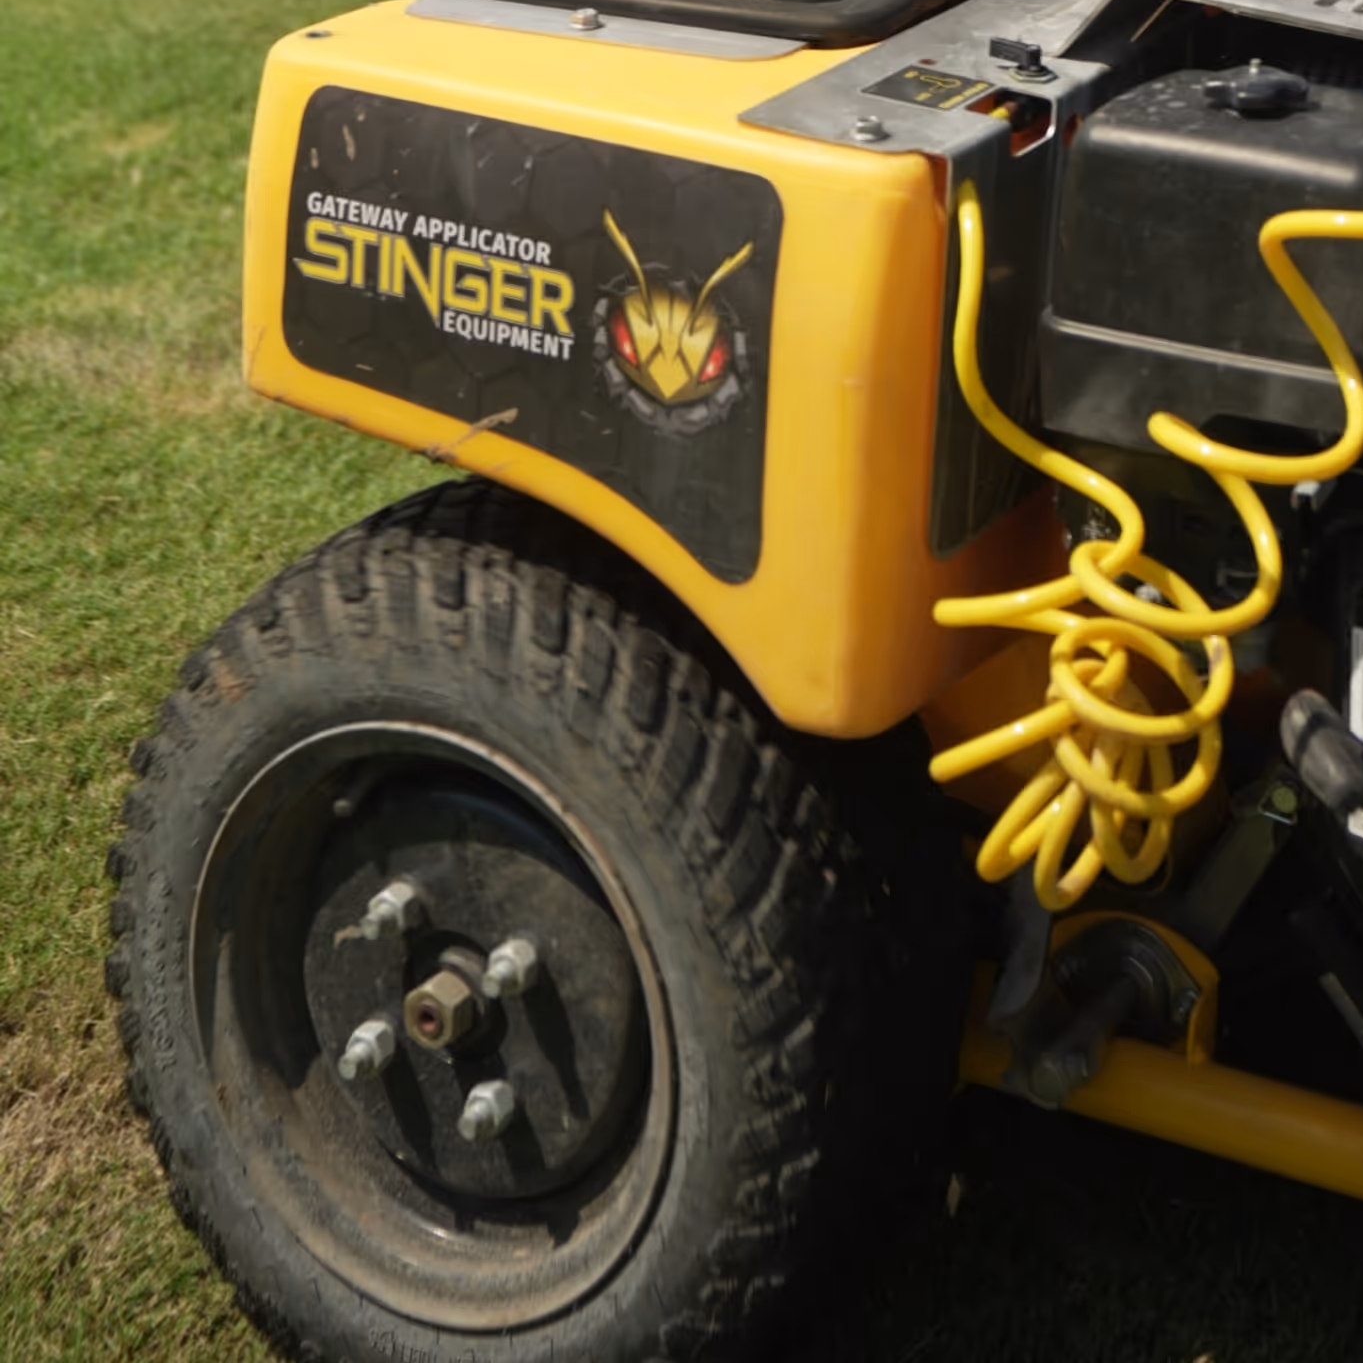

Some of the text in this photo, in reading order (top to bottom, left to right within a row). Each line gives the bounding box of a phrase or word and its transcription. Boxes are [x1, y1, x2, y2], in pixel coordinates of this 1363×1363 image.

[307, 192, 551, 265] GATEWAY APPLICATOR
[294, 217, 575, 337] STINGER
[443, 311, 574, 360] EQUIPMENT
